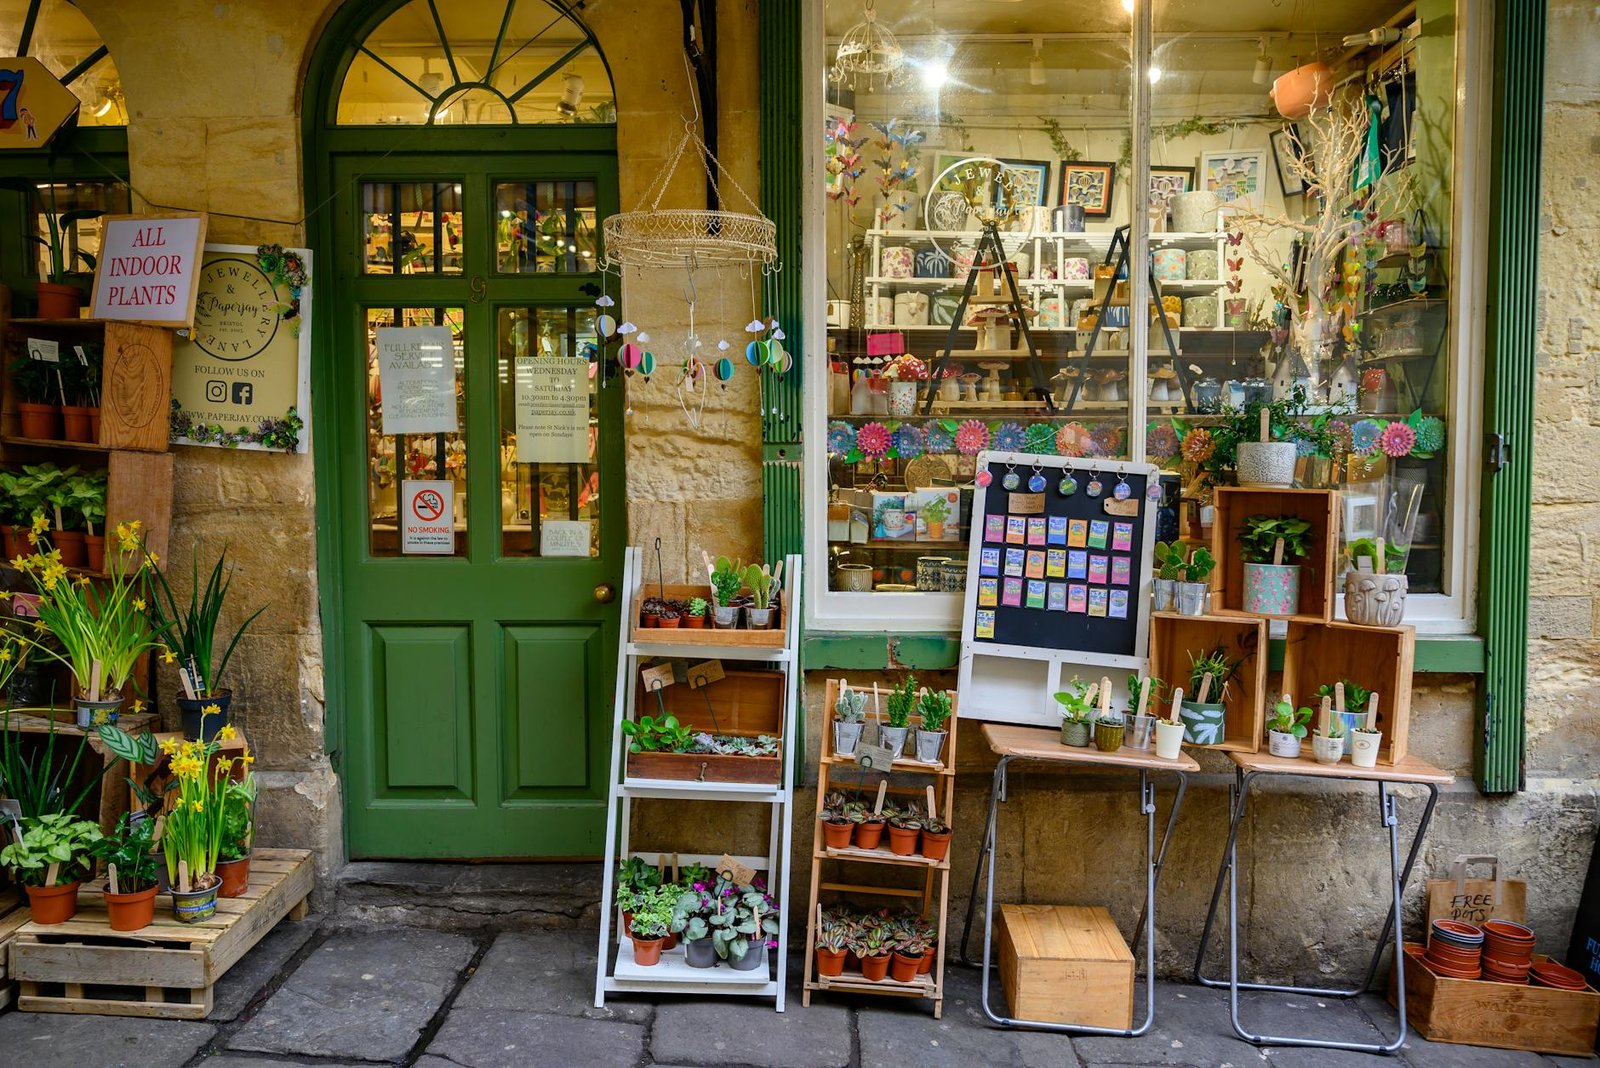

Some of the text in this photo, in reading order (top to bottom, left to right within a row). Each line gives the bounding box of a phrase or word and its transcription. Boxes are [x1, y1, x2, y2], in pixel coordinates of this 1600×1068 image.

[0, 69, 24, 121] 7
[132, 227, 166, 247] ALL
[109, 255, 182, 277] INDOOR
[107, 285, 176, 306] PLANTS
[227, 284, 235, 294] &
[208, 297, 259, 318] Paperjay
[384, 343, 410, 352] FULL
[194, 365, 265, 378] FOLLOW US ON
[560, 395, 587, 403] 4.30pm
[1450, 894, 1492, 908] FREE
